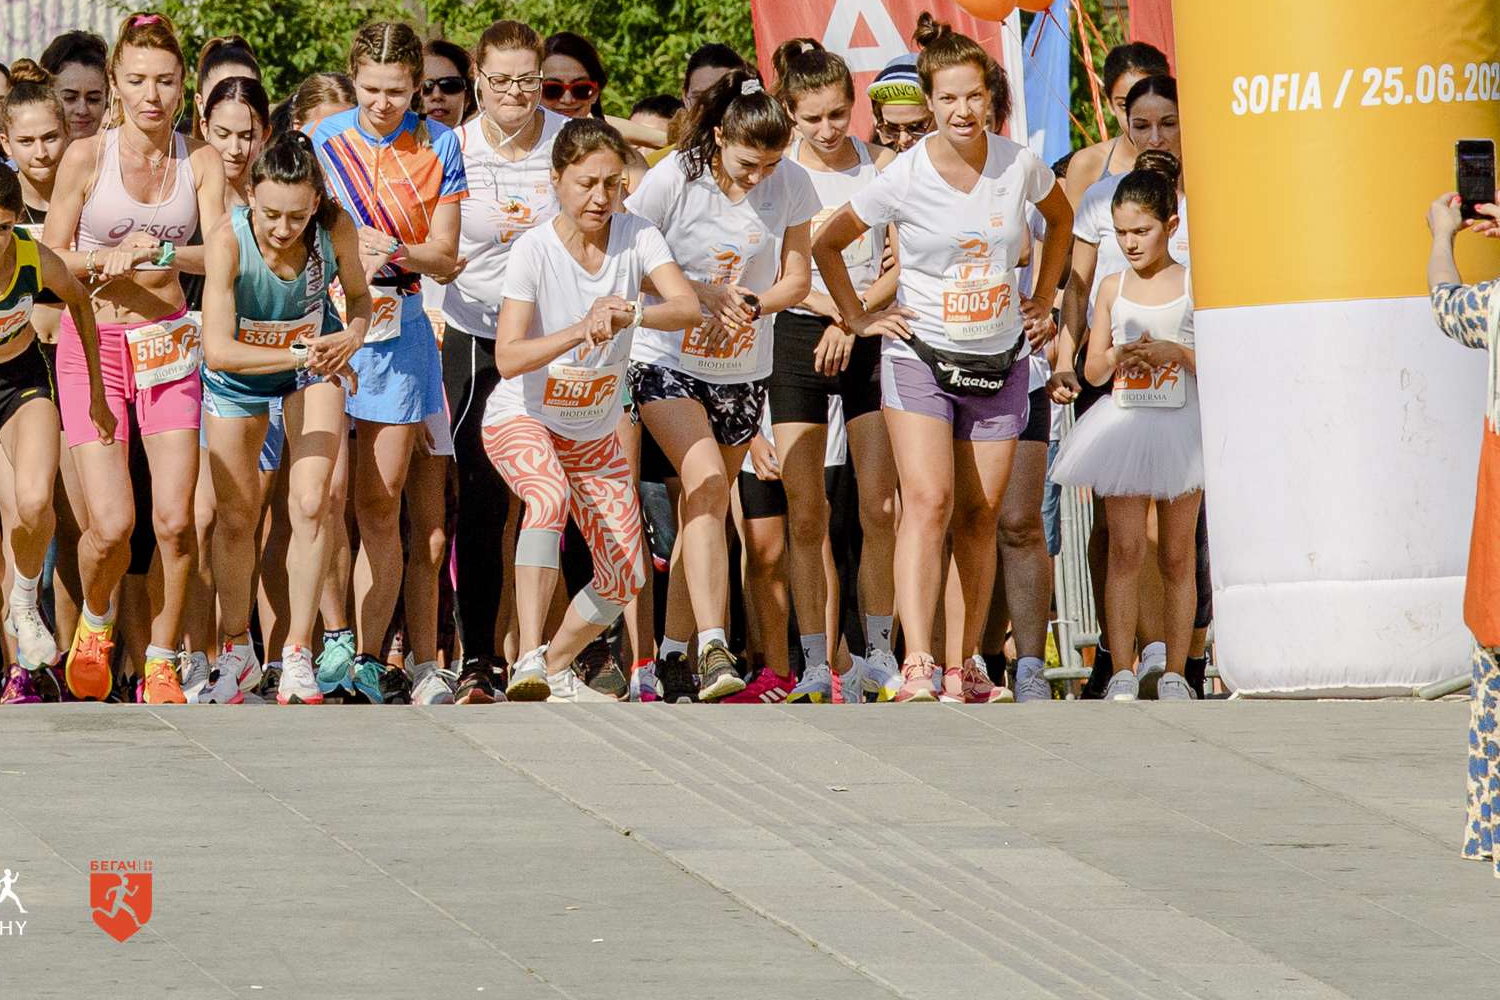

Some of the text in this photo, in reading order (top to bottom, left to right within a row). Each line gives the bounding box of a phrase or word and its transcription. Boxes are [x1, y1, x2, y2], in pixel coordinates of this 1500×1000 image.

[1231, 71, 1322, 116] SOFIA
[947, 292, 990, 312] 5003
[244, 331, 287, 345] 5361
[137, 335, 174, 362] 5155
[551, 380, 590, 397] 5161
